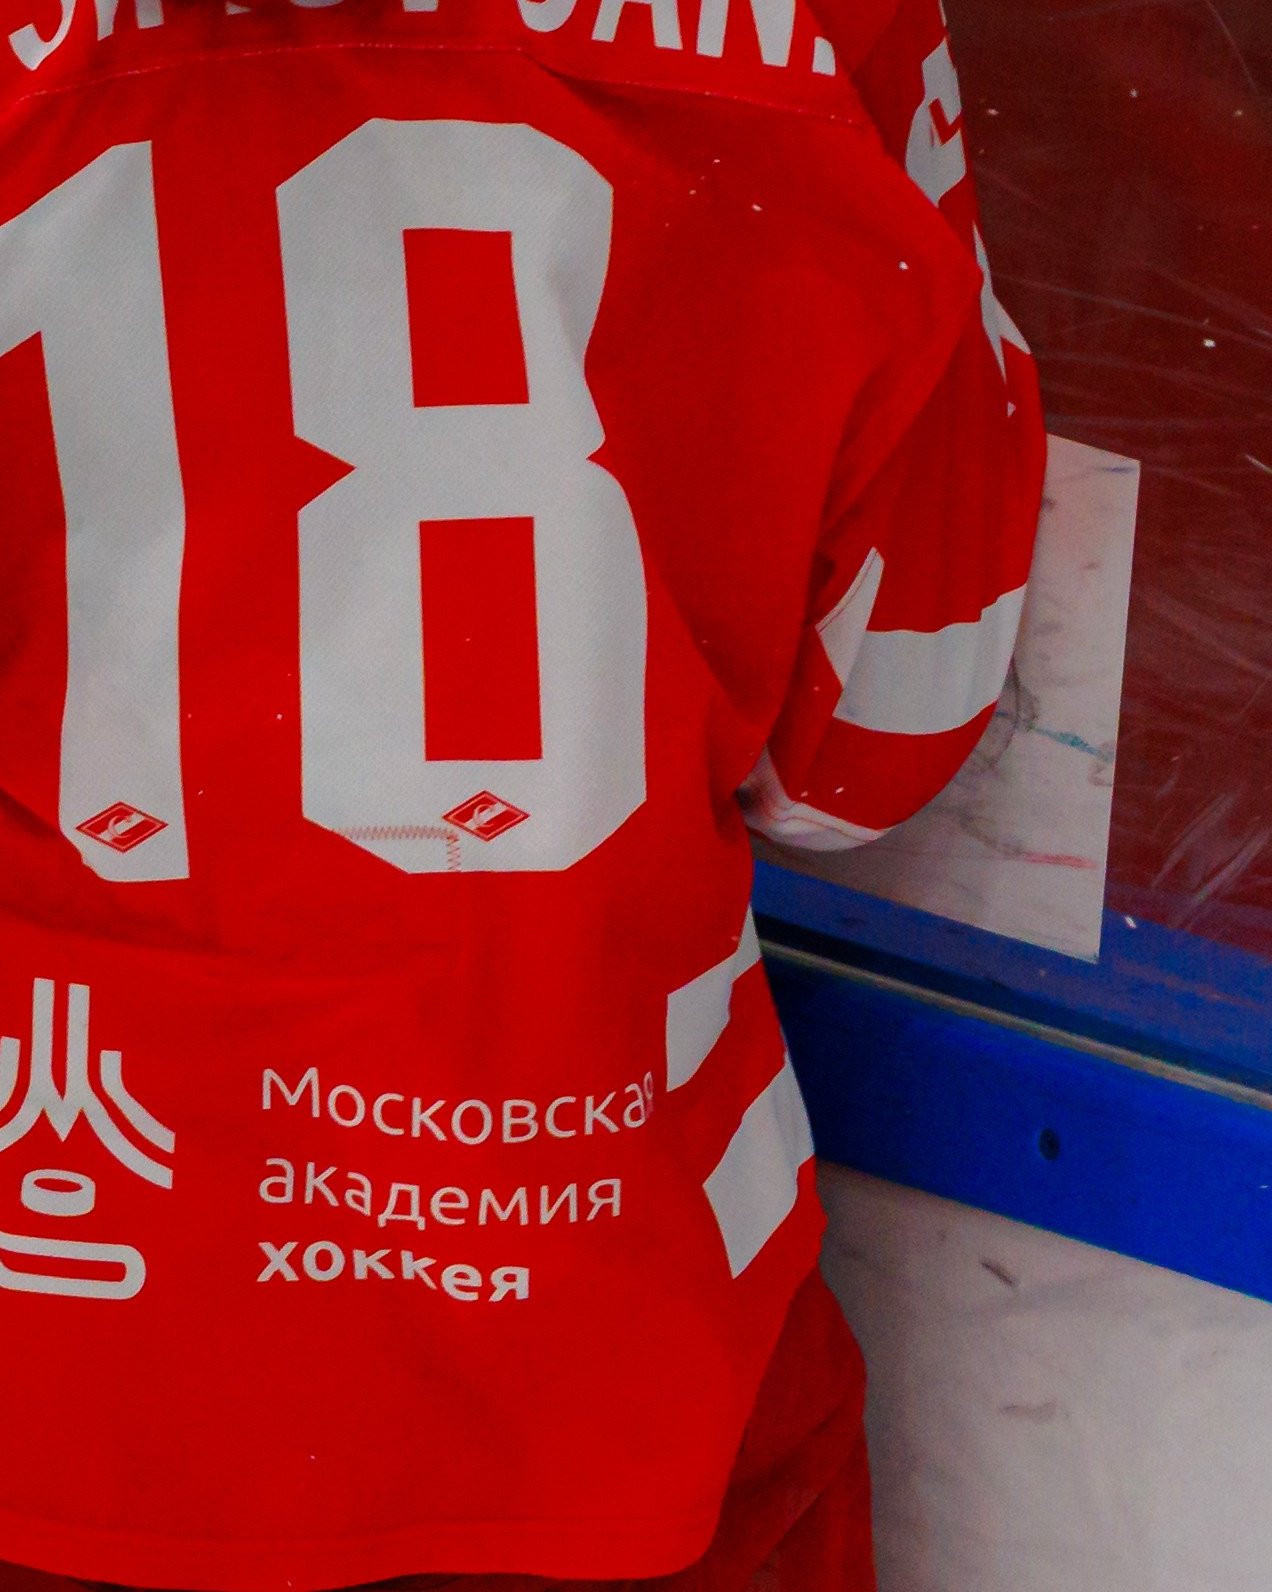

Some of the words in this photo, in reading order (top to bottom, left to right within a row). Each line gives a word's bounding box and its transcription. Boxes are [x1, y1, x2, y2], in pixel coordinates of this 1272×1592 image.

[260, 1067, 655, 1145] Московская
[257, 1156, 623, 1230] академия
[256, 1239, 531, 1303] хоккея
